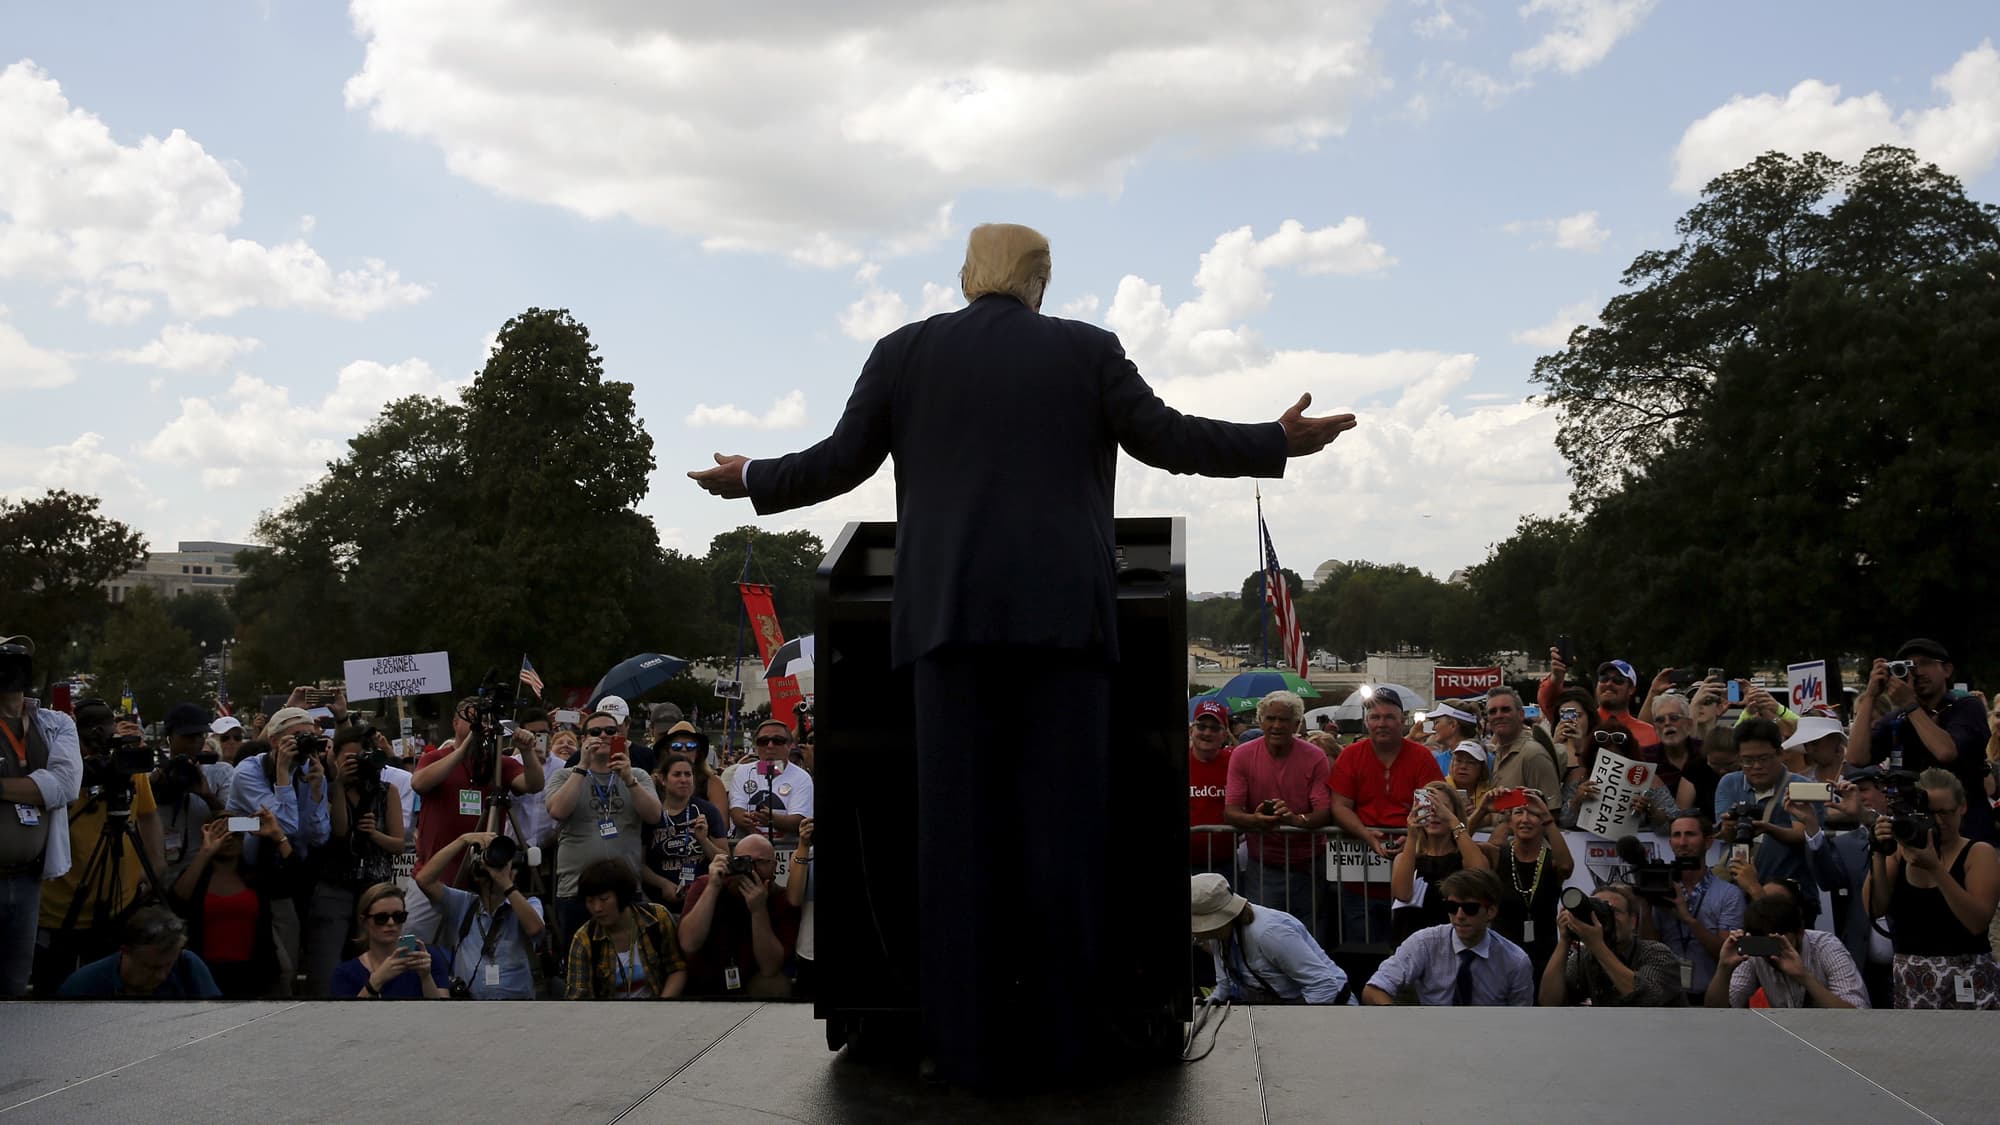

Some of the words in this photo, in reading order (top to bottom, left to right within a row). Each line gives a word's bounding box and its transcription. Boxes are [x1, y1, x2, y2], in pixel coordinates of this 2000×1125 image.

[377, 655, 414, 667] BOEHNER
[368, 677, 427, 692] REPUGNICANT
[1437, 674, 1500, 687] TRUMP
[1793, 673, 1823, 705] CWA
[379, 687, 421, 697] TRAITORS
[1596, 755, 1611, 785] DEA
[1631, 766, 1645, 785] STOP
[462, 792, 479, 801] VIP
[1594, 760, 1625, 835] NUCLEAR
[1613, 788, 1632, 825] IRAN
